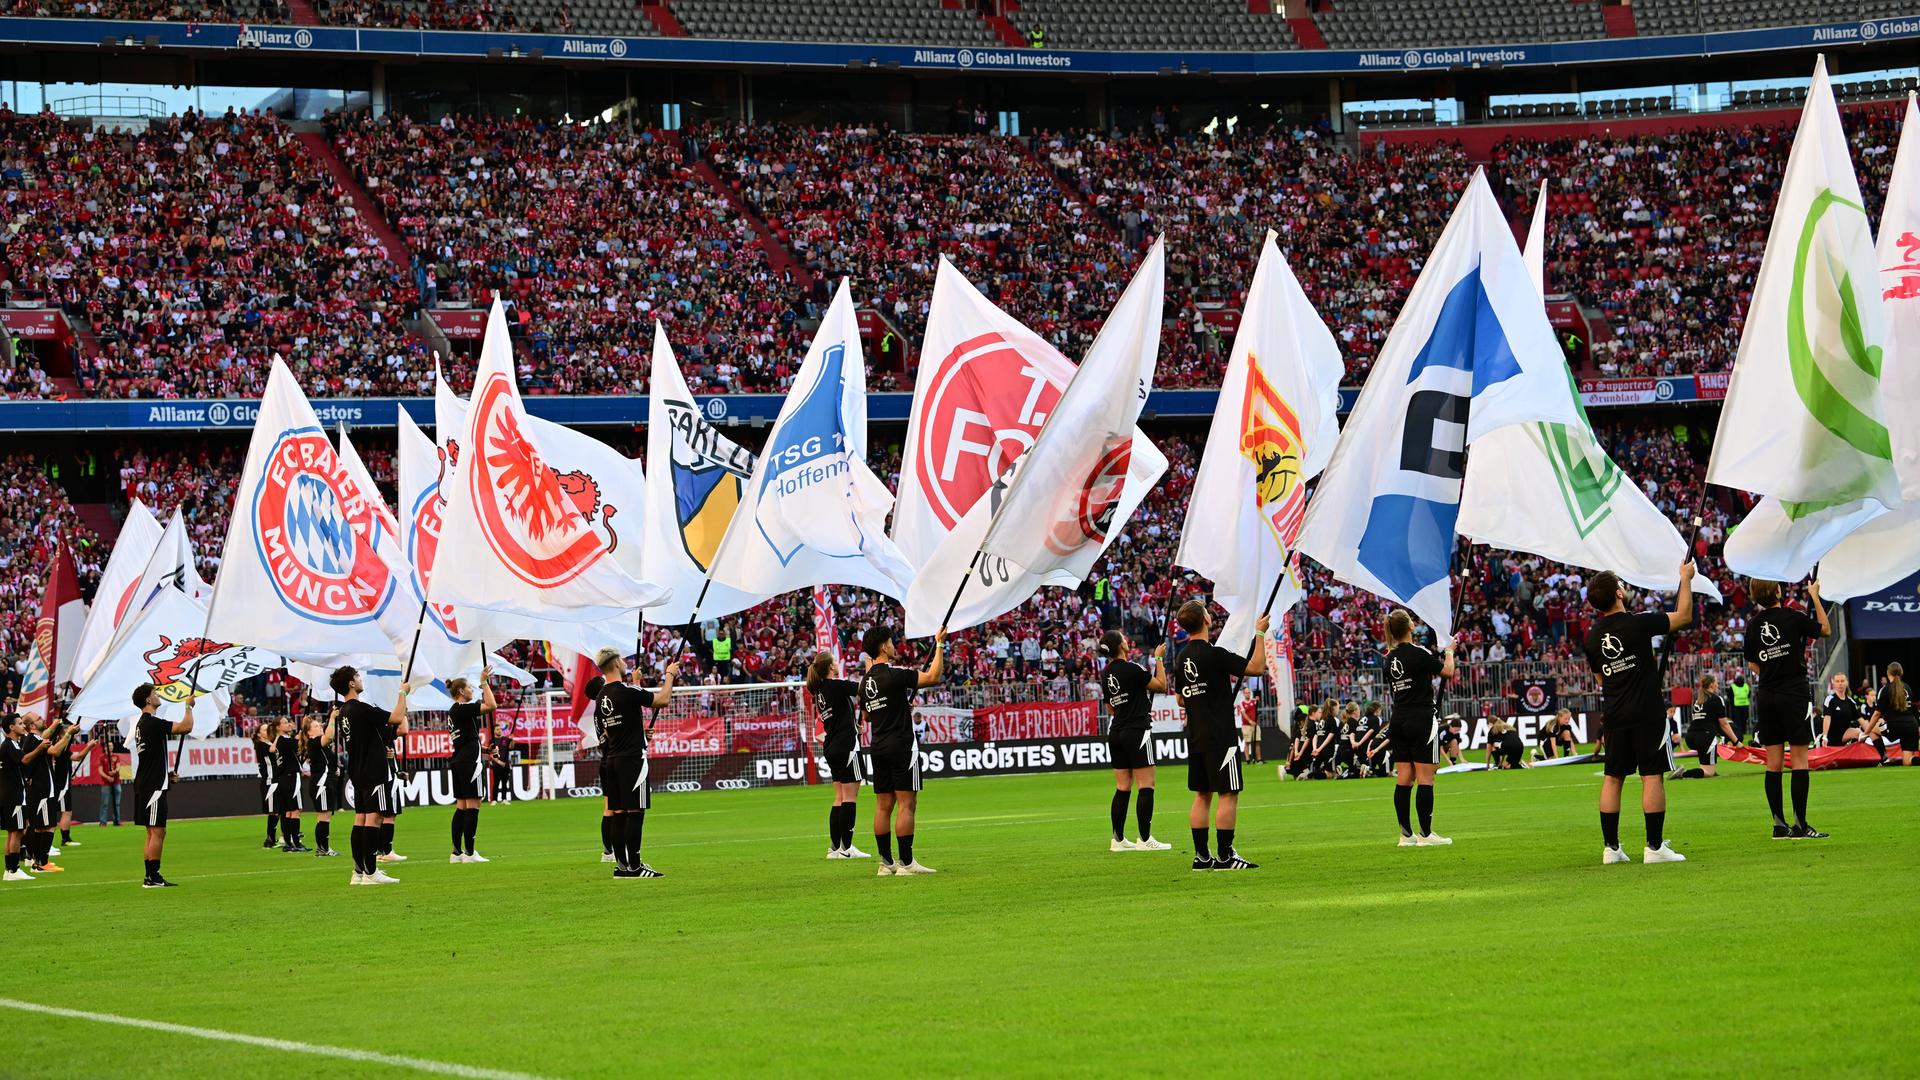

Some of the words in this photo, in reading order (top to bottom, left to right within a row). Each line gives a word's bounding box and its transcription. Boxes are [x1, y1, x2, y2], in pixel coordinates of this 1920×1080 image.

[245, 29, 292, 45] Allianz
[1813, 27, 1858, 40] Allianz
[563, 40, 608, 54] Allianz
[914, 50, 955, 63] Allianz
[976, 52, 1014, 65] Global
[1017, 53, 1071, 67] Investors
[1359, 54, 1401, 66] Allianz
[1423, 51, 1464, 64] Global
[1467, 49, 1526, 63] Investors
[1596, 380, 1653, 392] Supporters
[149, 405, 205, 422] Allianz
[770, 436, 821, 472] TSG
[989, 707, 1090, 741] BAZI-FREUNDE
[655, 738, 720, 754] MÄDELS
